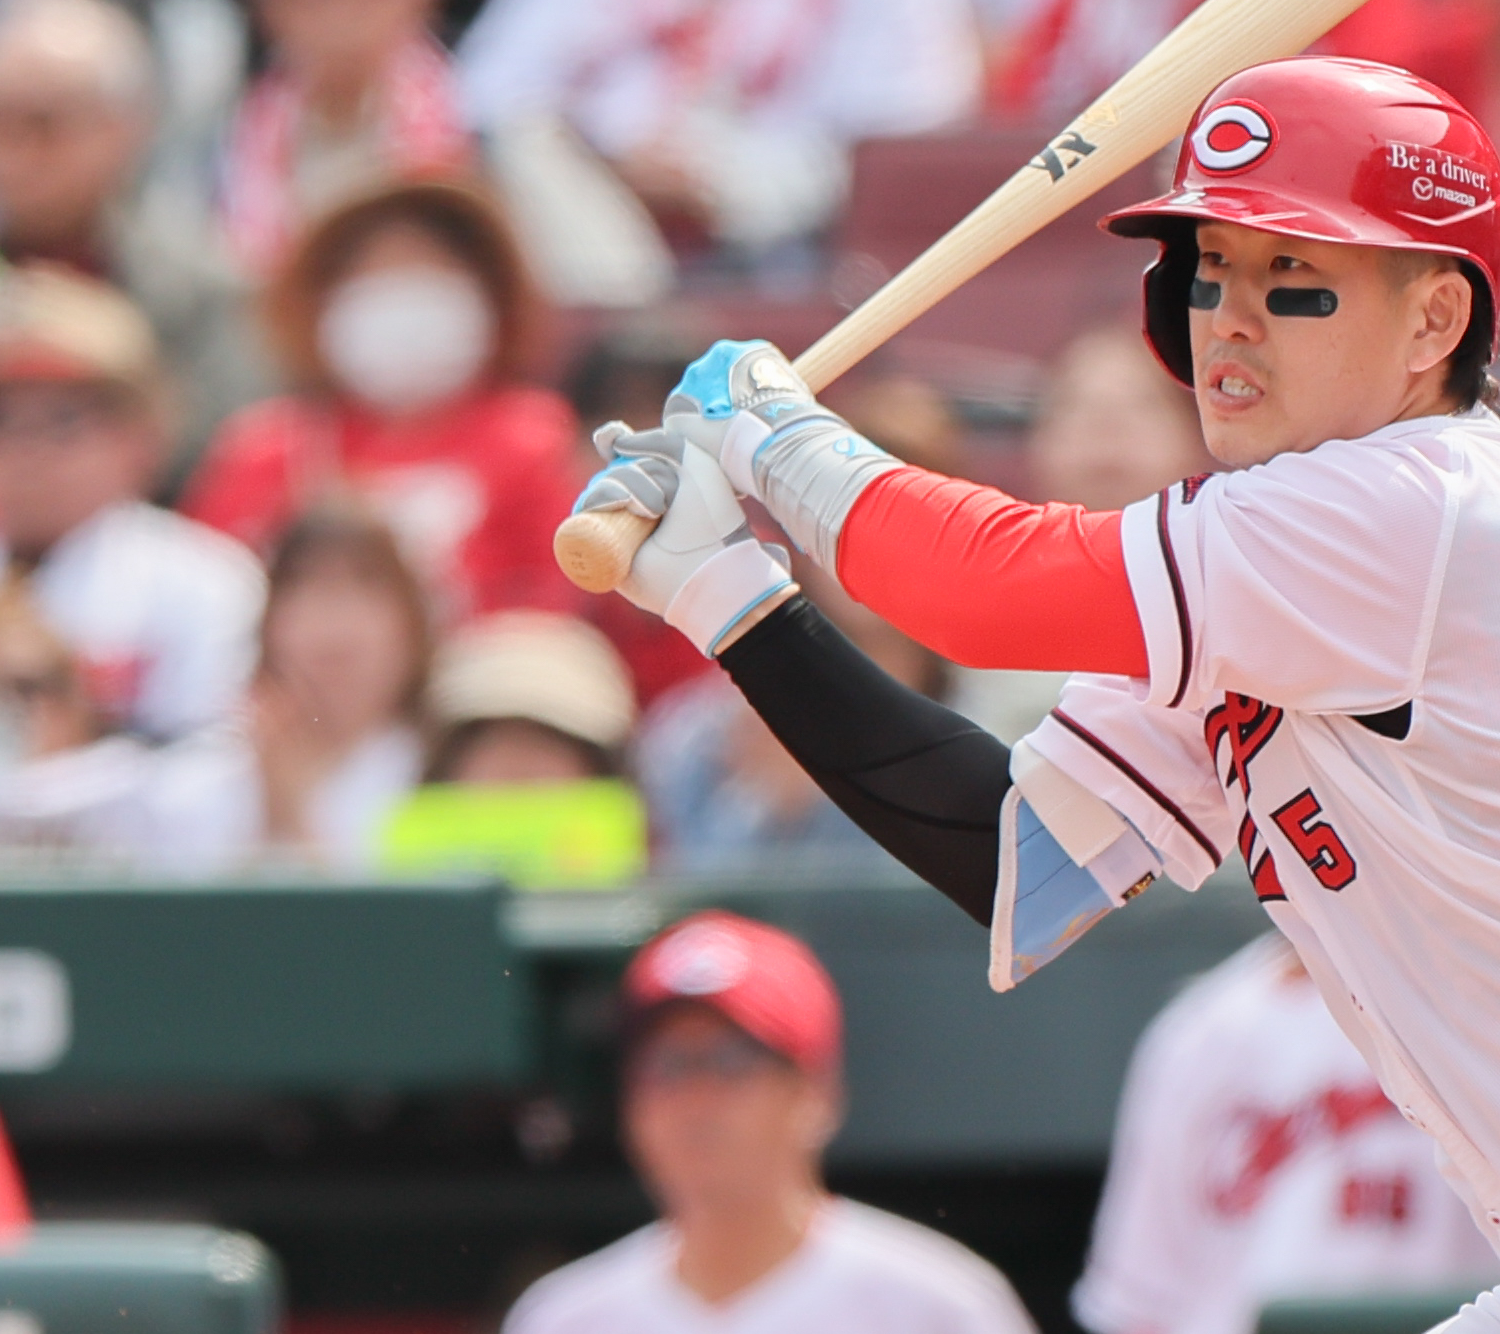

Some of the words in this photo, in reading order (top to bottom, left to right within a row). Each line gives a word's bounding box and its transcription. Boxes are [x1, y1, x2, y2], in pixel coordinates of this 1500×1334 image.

[1191, 105, 1270, 170] C
[1391, 143, 1420, 171] Be
[1425, 157, 1437, 175] a
[1441, 154, 1490, 193] driver.
[1269, 786, 1358, 893] 5
